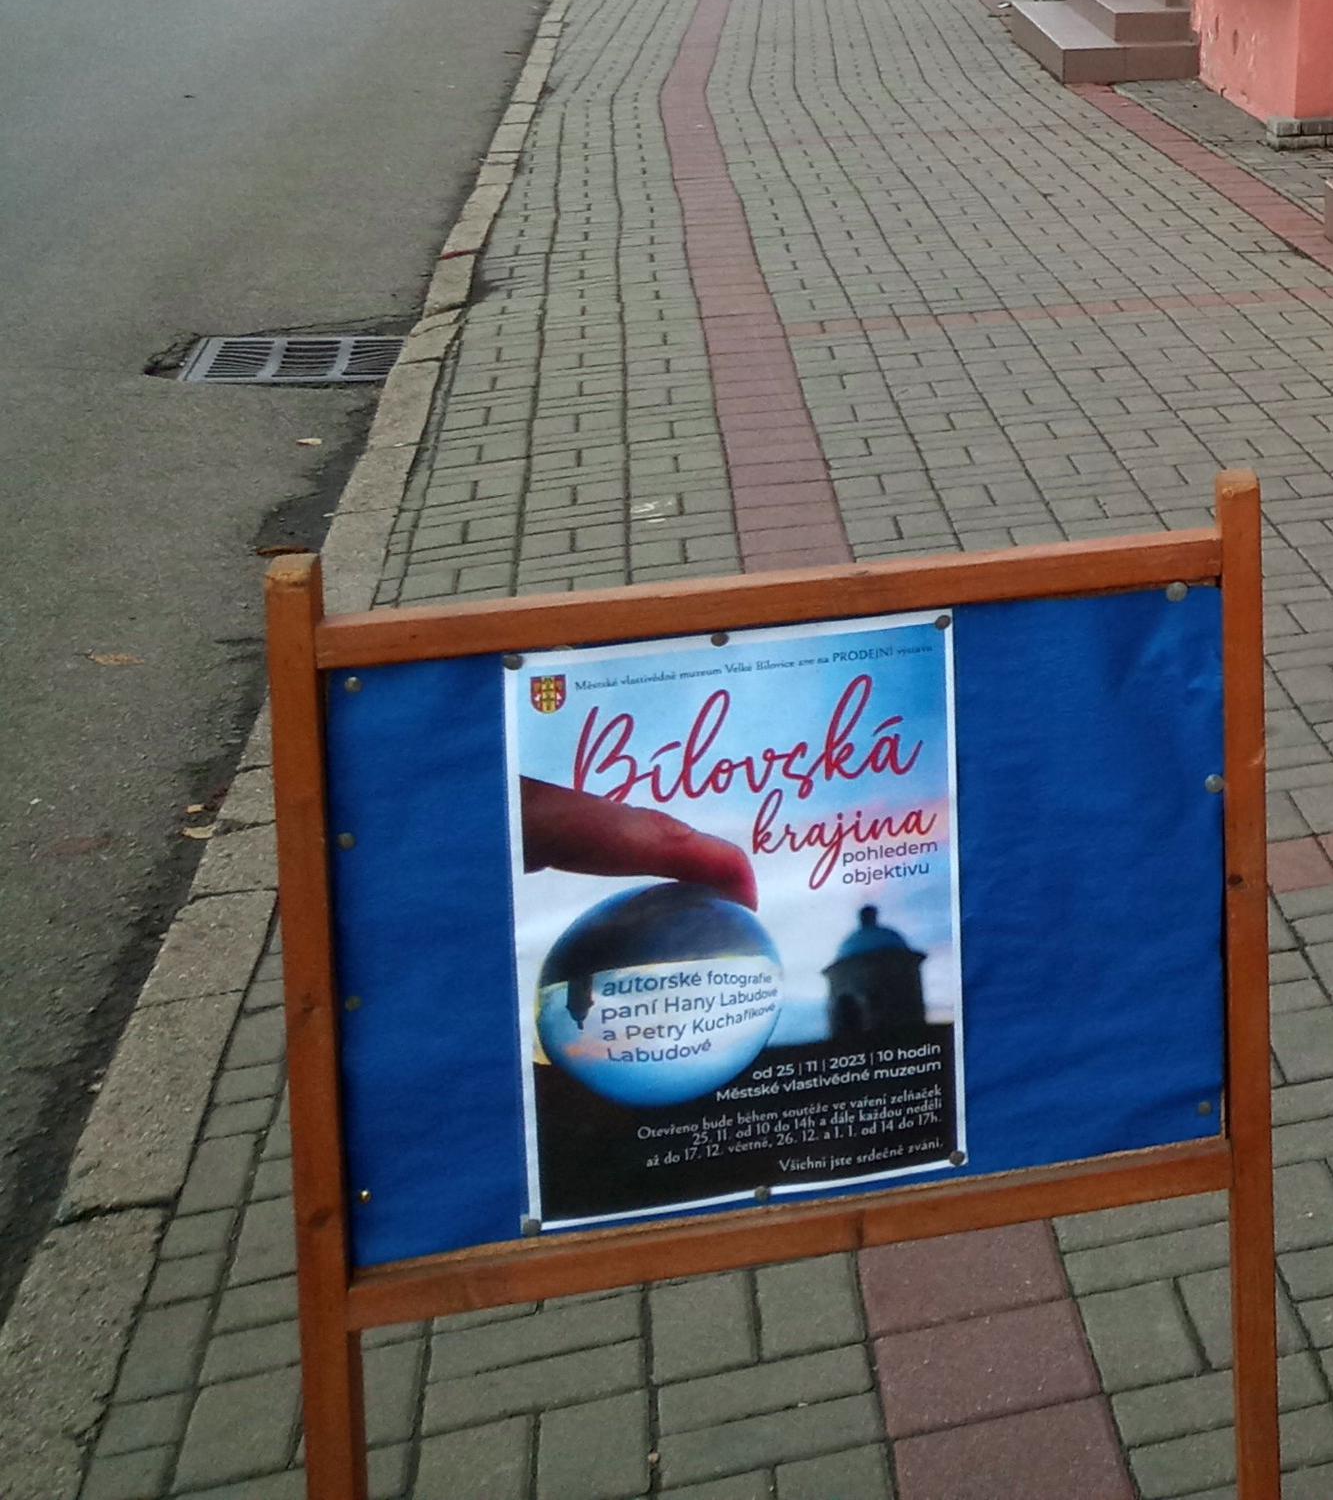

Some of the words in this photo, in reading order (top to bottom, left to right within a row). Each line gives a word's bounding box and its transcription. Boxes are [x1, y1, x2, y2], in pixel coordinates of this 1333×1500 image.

[680, 668, 722, 679] muzeum
[573, 673, 924, 803] Bílovská
[841, 837, 939, 867] pohledem
[841, 861, 931, 887] objektivu
[602, 972, 702, 997] autorské
[707, 970, 772, 988] fotografie
[601, 998, 658, 1024] paní
[665, 994, 716, 1014] Hany
[720, 988, 778, 1007] Labudové
[602, 1029, 617, 1042] a
[626, 1024, 687, 1042] Petry
[692, 1002, 776, 1035] Kuchaříkové
[607, 1039, 712, 1063] Labudové
[752, 1066, 773, 1080] od
[777, 1064, 795, 1077] 25
[806, 1060, 817, 1073] 11
[829, 1053, 866, 1070] 2023
[877, 1050, 894, 1062] 10
[897, 1043, 942, 1060] hodin
[716, 1081, 780, 1102] Městské
[782, 1069, 870, 1093] vlastivědné
[873, 1060, 942, 1080] muzeum
[637, 1124, 699, 1140] Otevřeno
[702, 1114, 734, 1130] bude
[737, 1109, 779, 1125] během
[782, 1102, 829, 1119] soutěže
[833, 1101, 847, 1110] ve
[850, 1093, 887, 1109] vaření
[890, 1083, 942, 1104] zelňaček
[736, 1124, 752, 1139] od
[756, 1122, 771, 1135] 10
[774, 1120, 790, 1133] do
[794, 1116, 816, 1130] 14h
[819, 1117, 827, 1125] a
[830, 1110, 855, 1125] dále
[859, 1106, 903, 1122] každou
[906, 1097, 943, 1114] neděli
[646, 1154, 660, 1168] až
[663, 1151, 681, 1165] do
[823, 1131, 831, 1140] a
[861, 1123, 877, 1136] od
[881, 1120, 894, 1133] 14
[898, 1116, 914, 1130] do
[778, 1155, 827, 1173] Všichni
[830, 1155, 853, 1171] jste
[856, 1146, 904, 1164] srdečně
